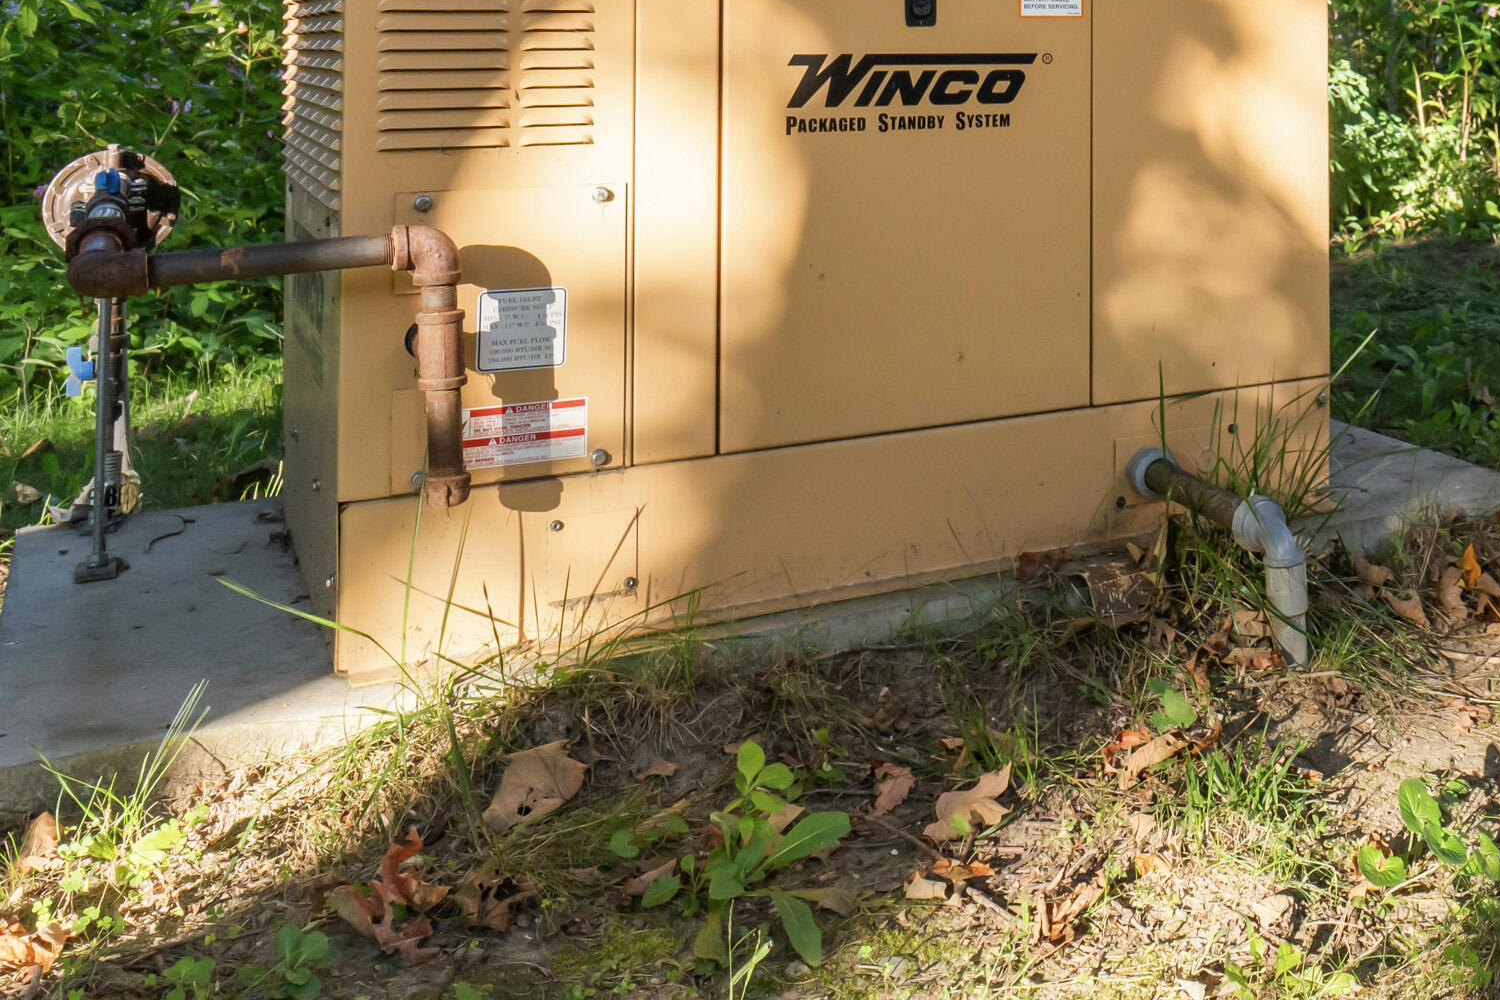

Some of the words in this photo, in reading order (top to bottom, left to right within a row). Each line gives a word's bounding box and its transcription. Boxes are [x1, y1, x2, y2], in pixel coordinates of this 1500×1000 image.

[786, 53, 1038, 108] WINCO
[498, 296, 516, 305] FUEL
[490, 338, 508, 346] MAX
[509, 337, 529, 345] FUEL
[530, 336, 551, 344] FLOW
[516, 402, 553, 412] DANGER
[499, 434, 537, 444] DANGER
